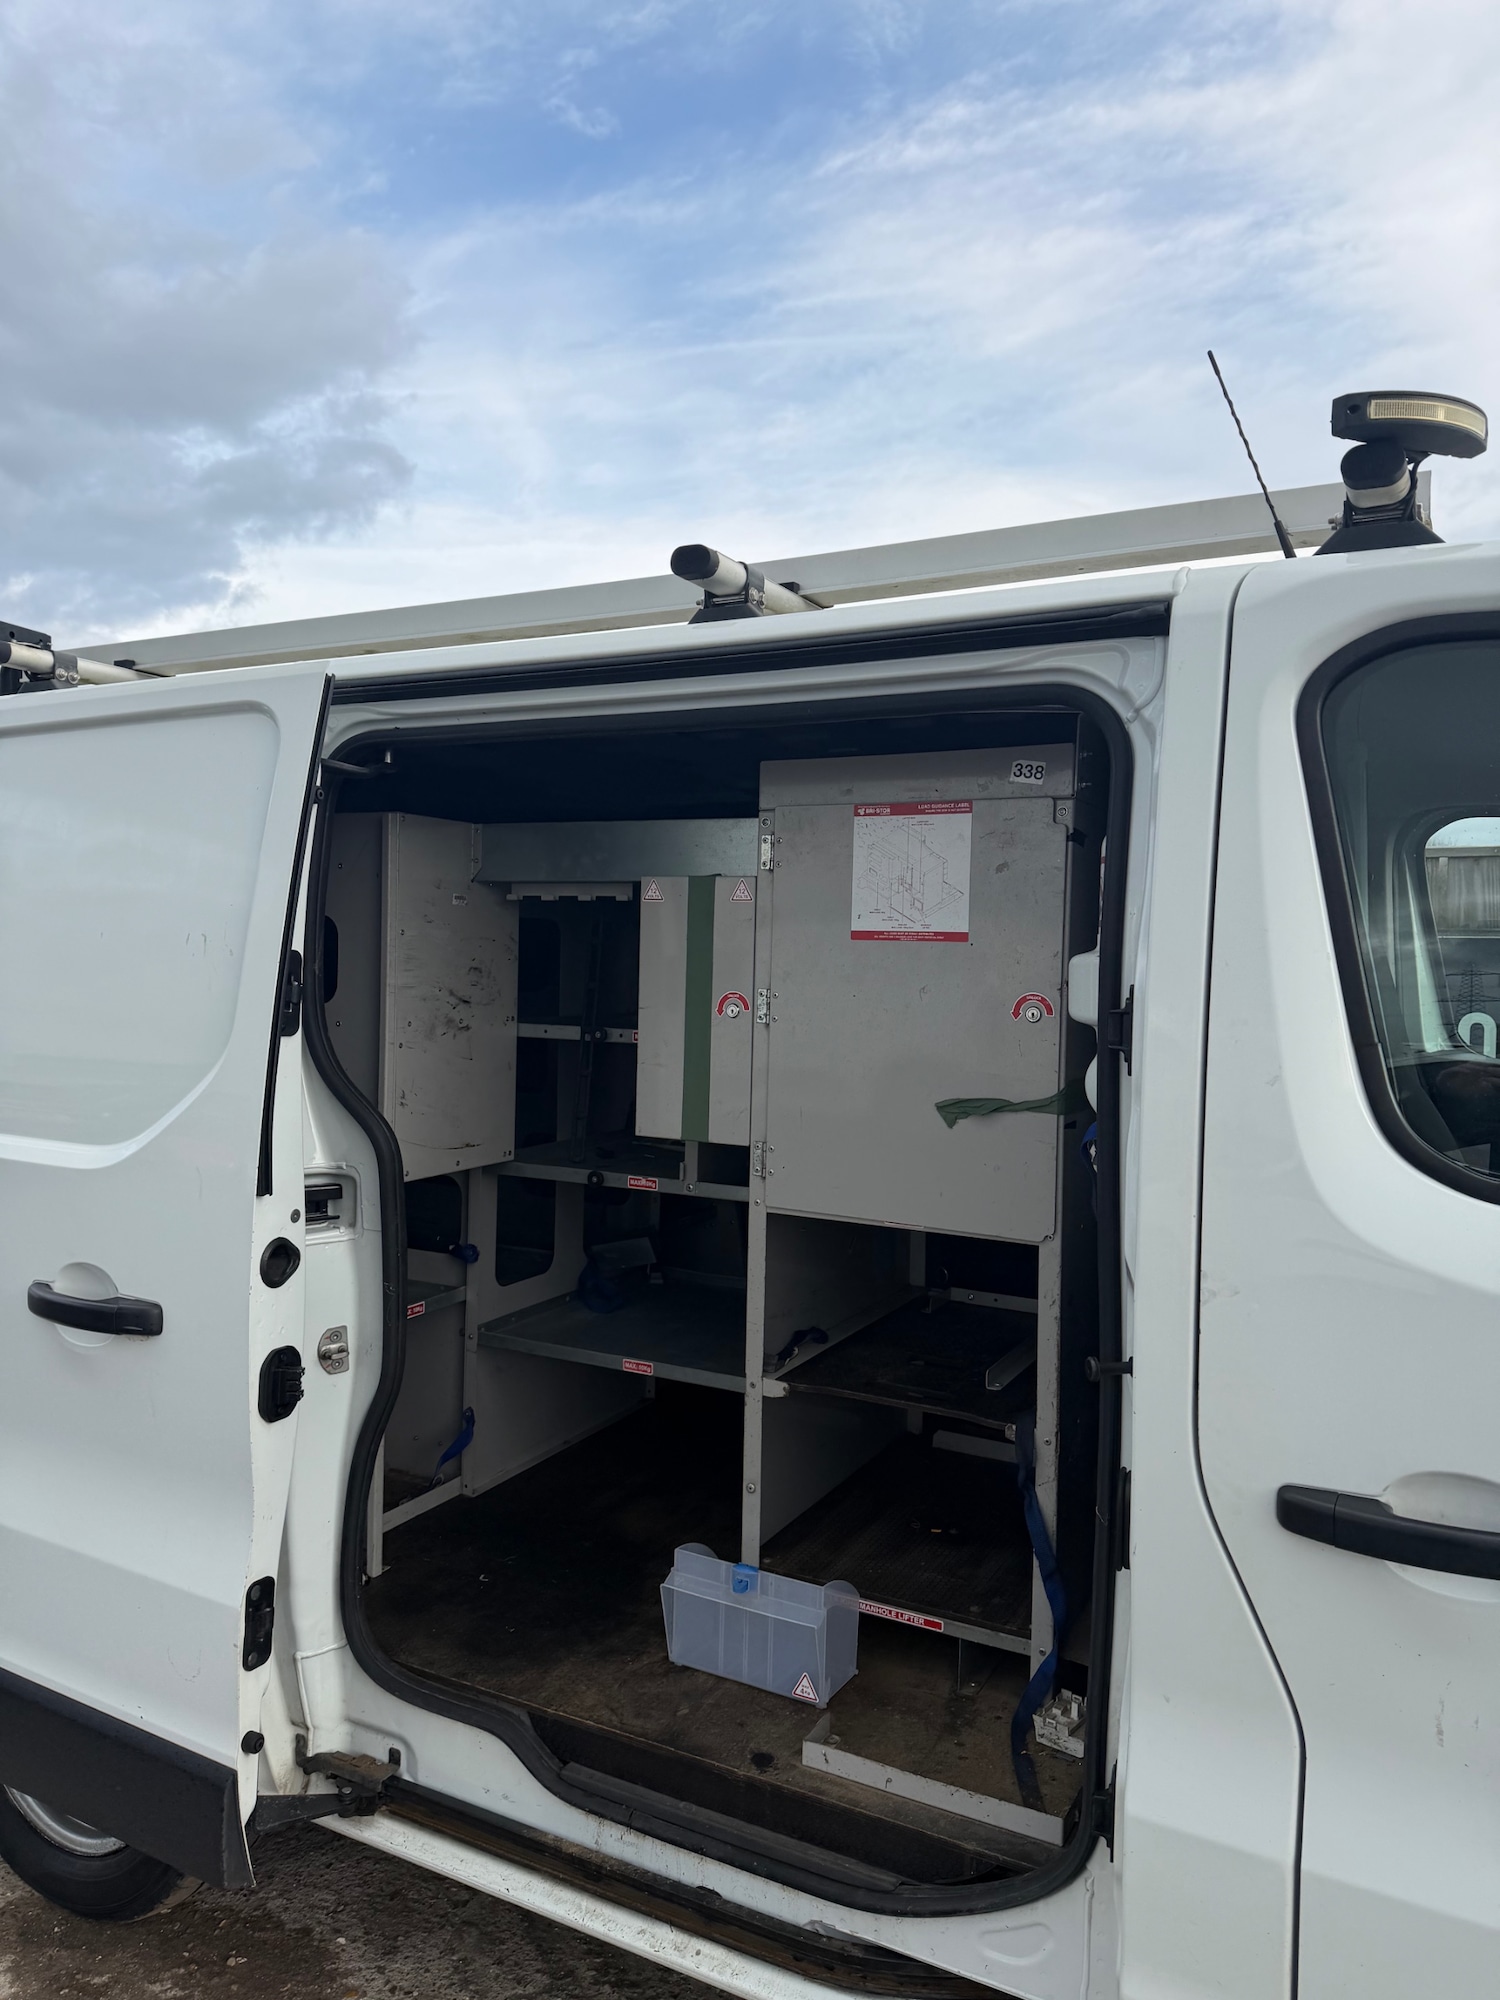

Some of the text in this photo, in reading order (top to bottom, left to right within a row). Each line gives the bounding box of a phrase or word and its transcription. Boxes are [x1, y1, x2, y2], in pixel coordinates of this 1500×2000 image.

[1013, 762, 1045, 780] 338
[859, 1602, 925, 1626] MANHOLE LIFTER
